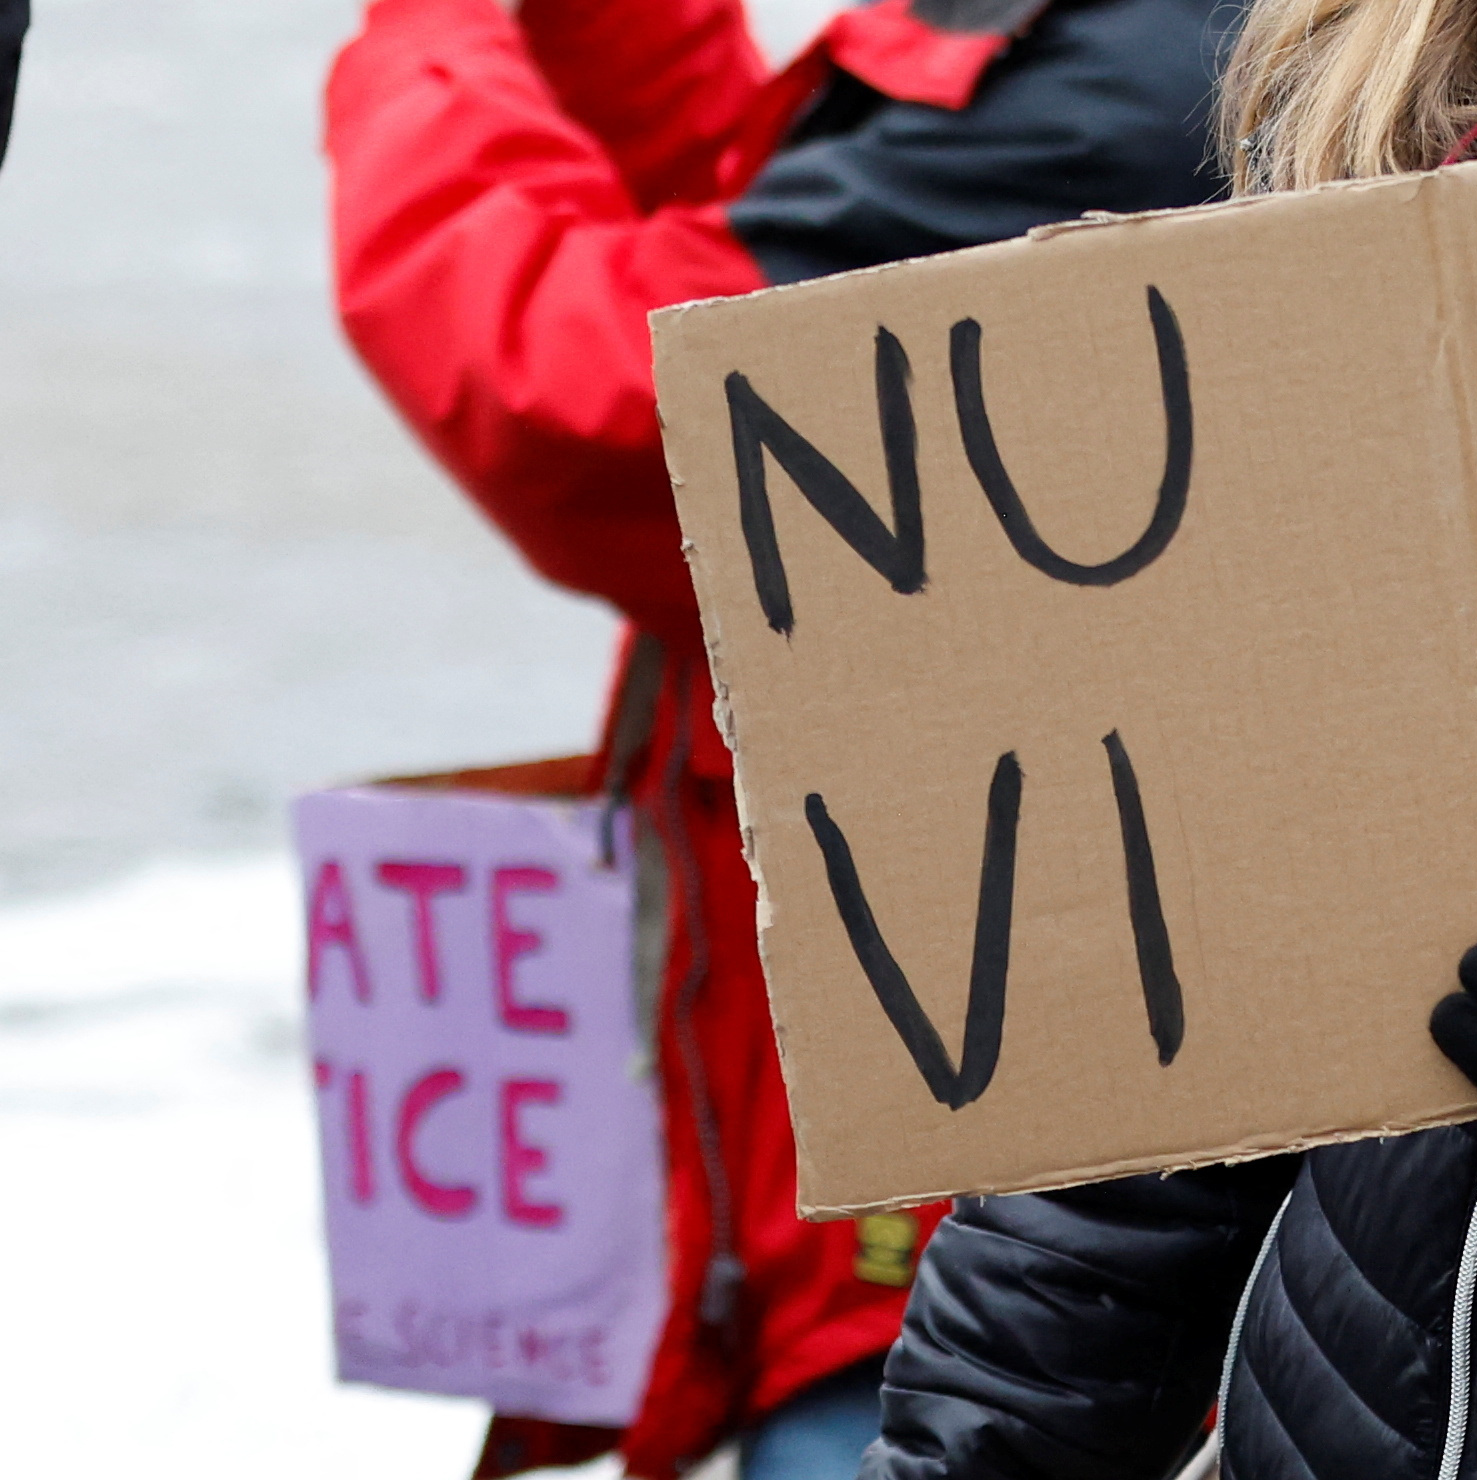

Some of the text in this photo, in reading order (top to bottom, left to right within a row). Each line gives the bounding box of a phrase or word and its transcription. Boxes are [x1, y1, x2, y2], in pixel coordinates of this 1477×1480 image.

[723, 282, 1196, 640] NU
[308, 860, 571, 1035] ATE
[803, 727, 1186, 1113] VI
[315, 1061, 565, 1230] ICE
